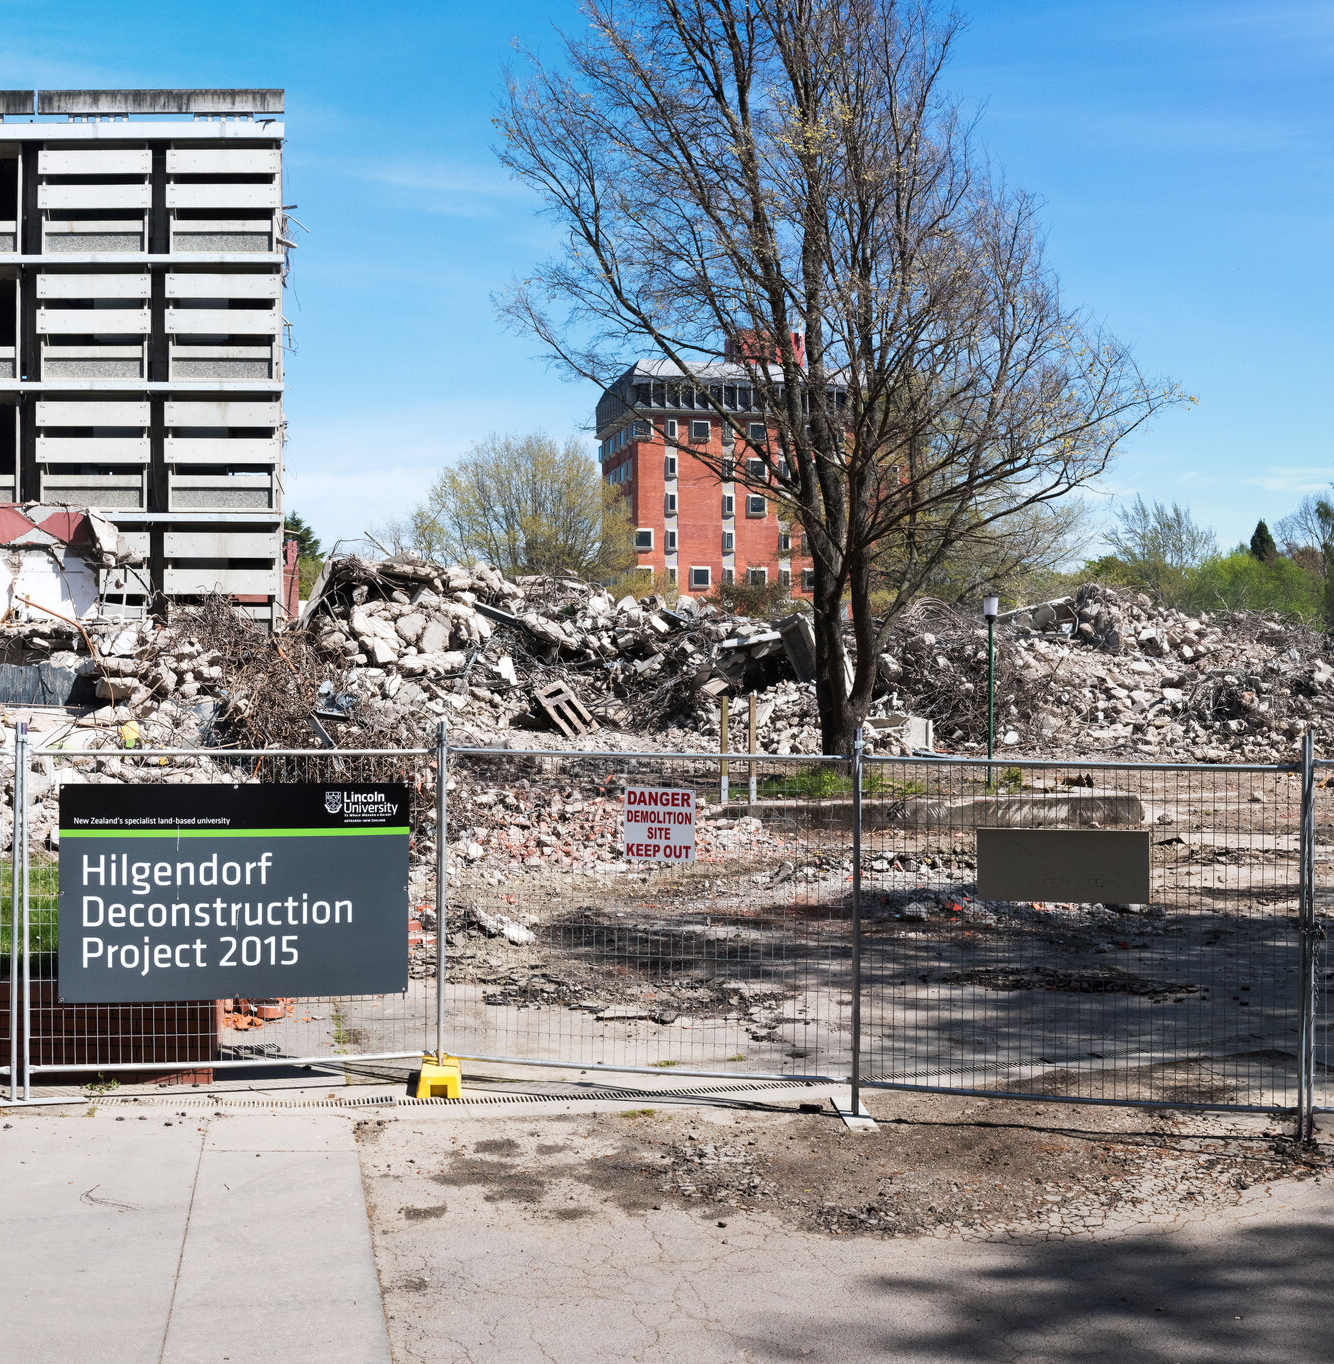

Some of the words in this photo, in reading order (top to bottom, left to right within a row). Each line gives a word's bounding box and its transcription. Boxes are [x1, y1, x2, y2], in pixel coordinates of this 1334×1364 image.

[344, 792, 385, 802] Lincoln
[627, 791, 691, 807] DANGER
[344, 802, 398, 815] University
[125, 817, 156, 825] specialist
[197, 817, 230, 825] university
[627, 810, 692, 825] DEMOLITION
[647, 827, 671, 840] SITE
[627, 843, 661, 857] KEEP
[663, 845, 691, 859] OUT
[83, 852, 273, 894] Hilgendorf
[83, 893, 353, 927] Deconstruction
[83, 936, 207, 976] Project
[219, 936, 299, 967] 2015
